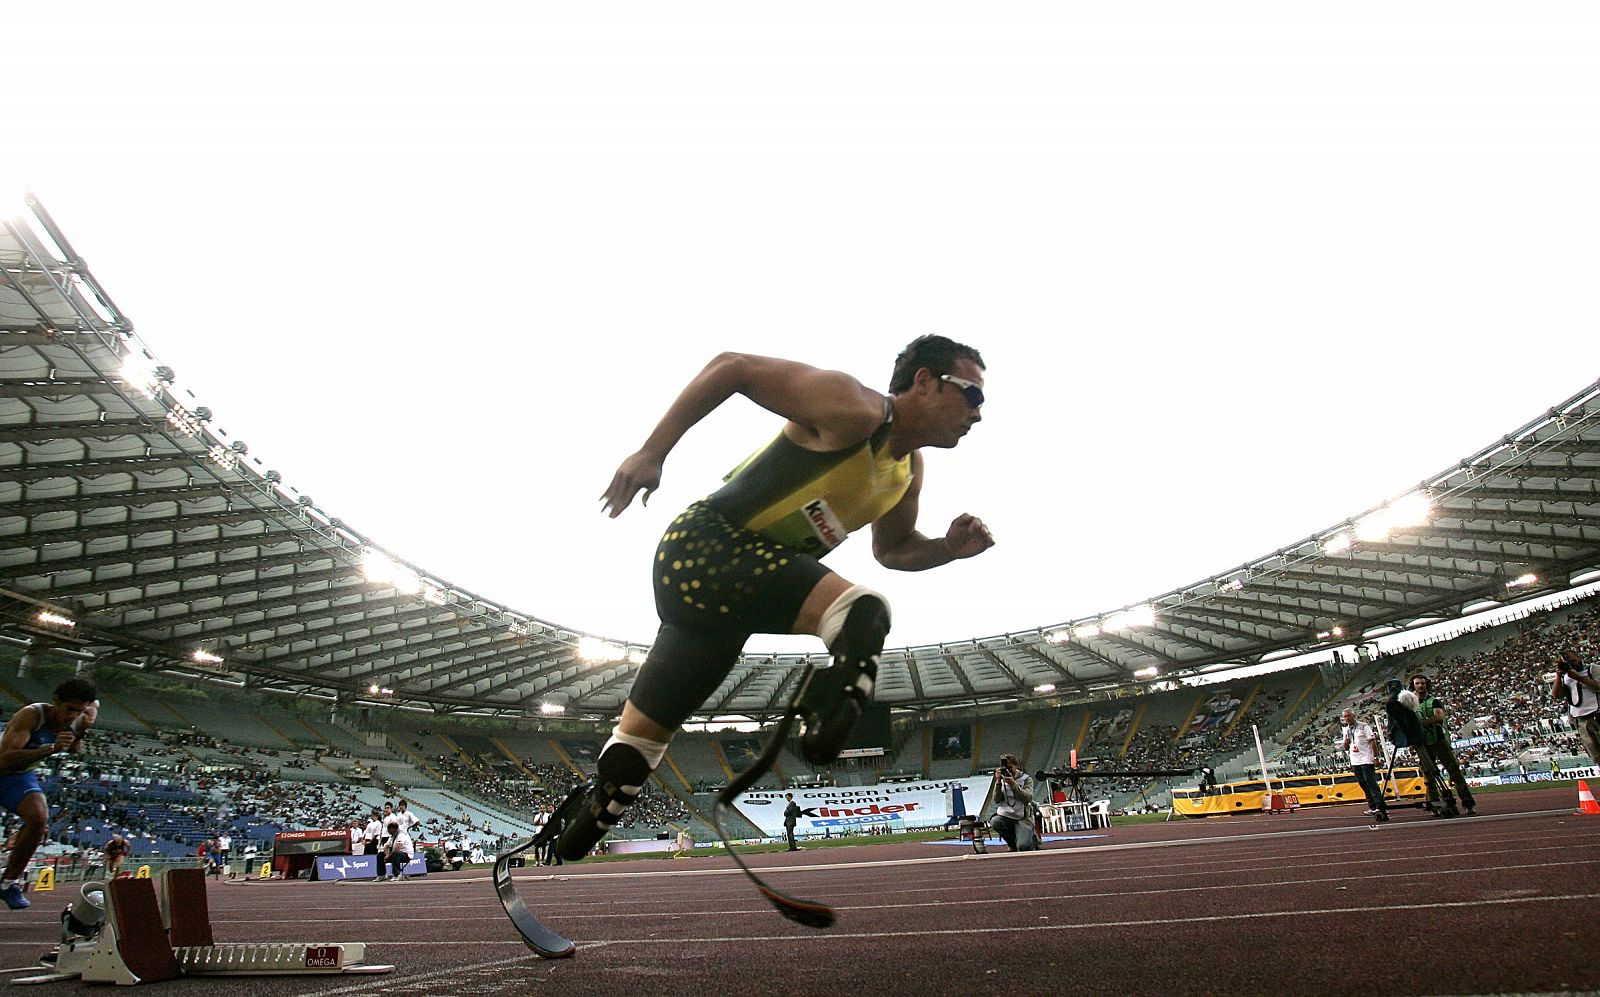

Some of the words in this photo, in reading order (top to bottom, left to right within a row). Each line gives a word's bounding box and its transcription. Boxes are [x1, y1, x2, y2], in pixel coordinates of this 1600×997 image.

[803, 789, 879, 798] GOLDEN
[824, 796, 890, 805] ROMA
[838, 813, 893, 825] SPORT
[263, 865, 269, 875] 2
[324, 861, 335, 870] Rai
[352, 860, 369, 869] Sport
[41, 872, 50, 886] 4
[307, 958, 336, 966] OMEGA
